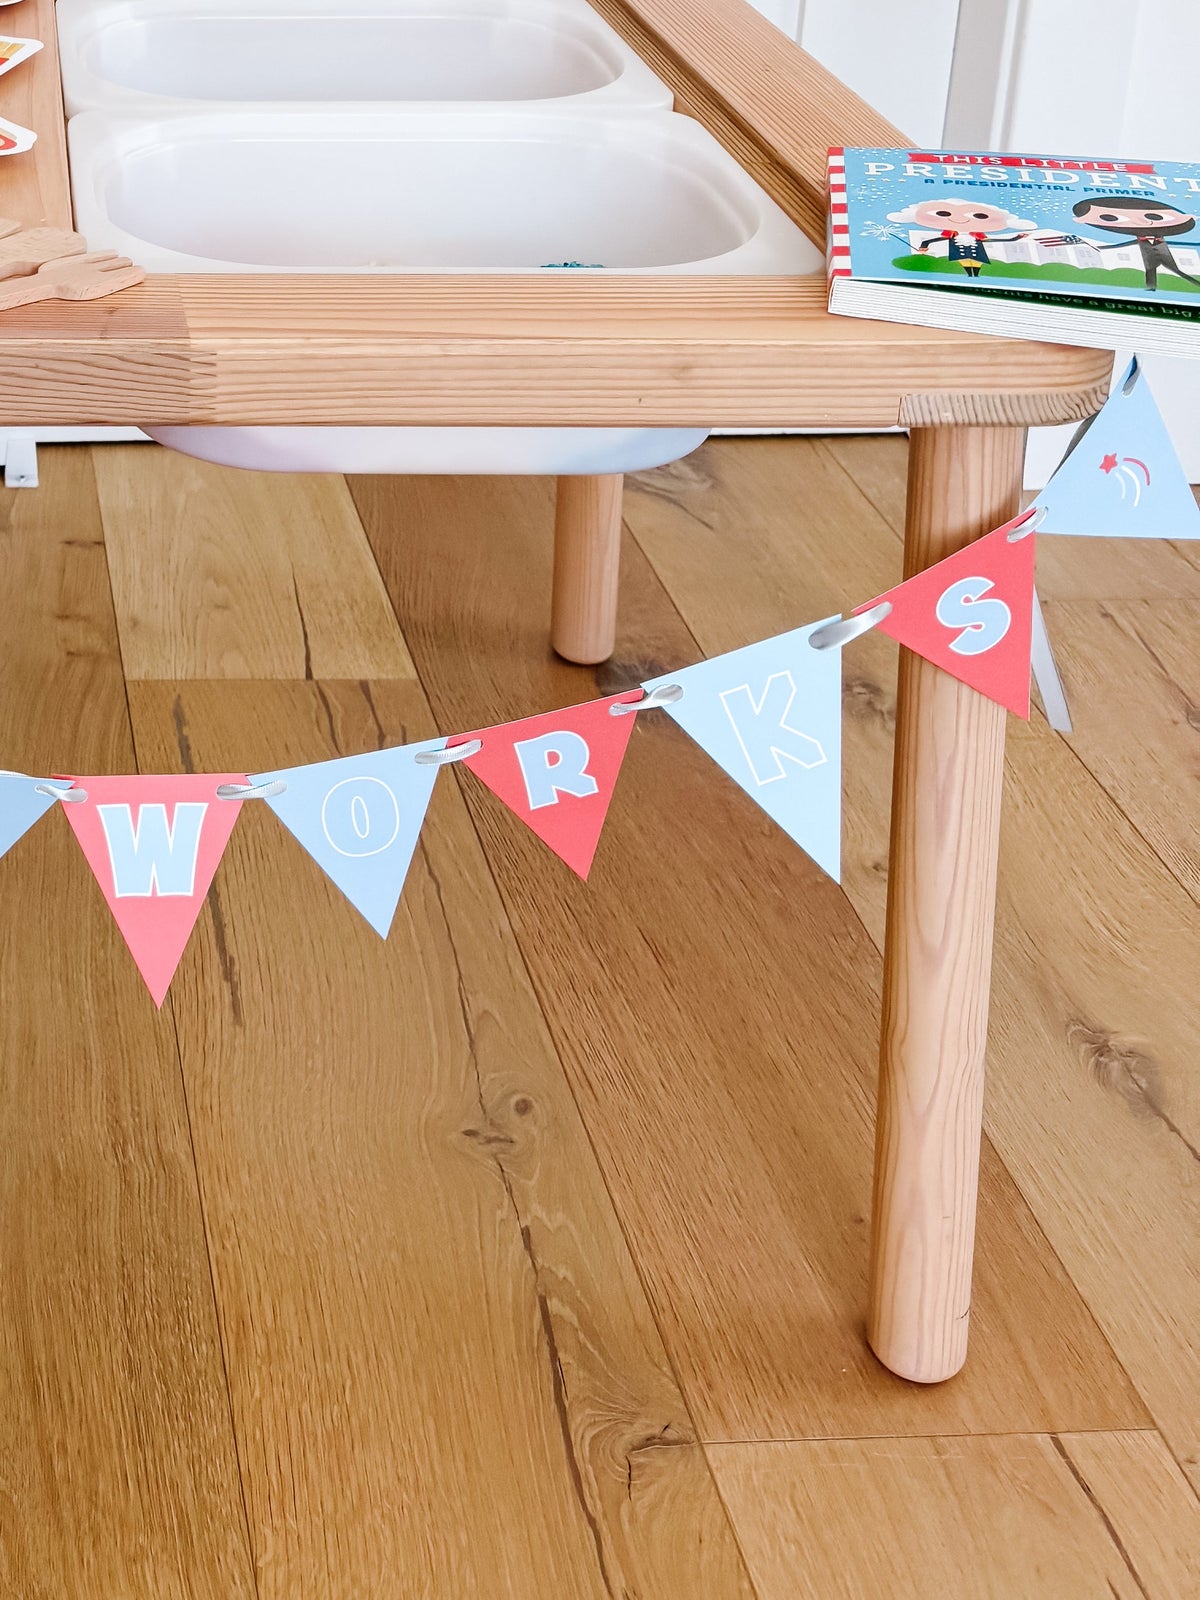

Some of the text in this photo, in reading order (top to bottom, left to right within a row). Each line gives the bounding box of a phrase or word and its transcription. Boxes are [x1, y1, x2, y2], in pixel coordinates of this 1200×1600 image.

[933, 154, 1129, 172] THIS LITTLE
[864, 162, 1200, 193] PRESIDENT
[943, 179, 1076, 192] PRESIDENTIAL
[1083, 186, 1155, 197] PRIMER
